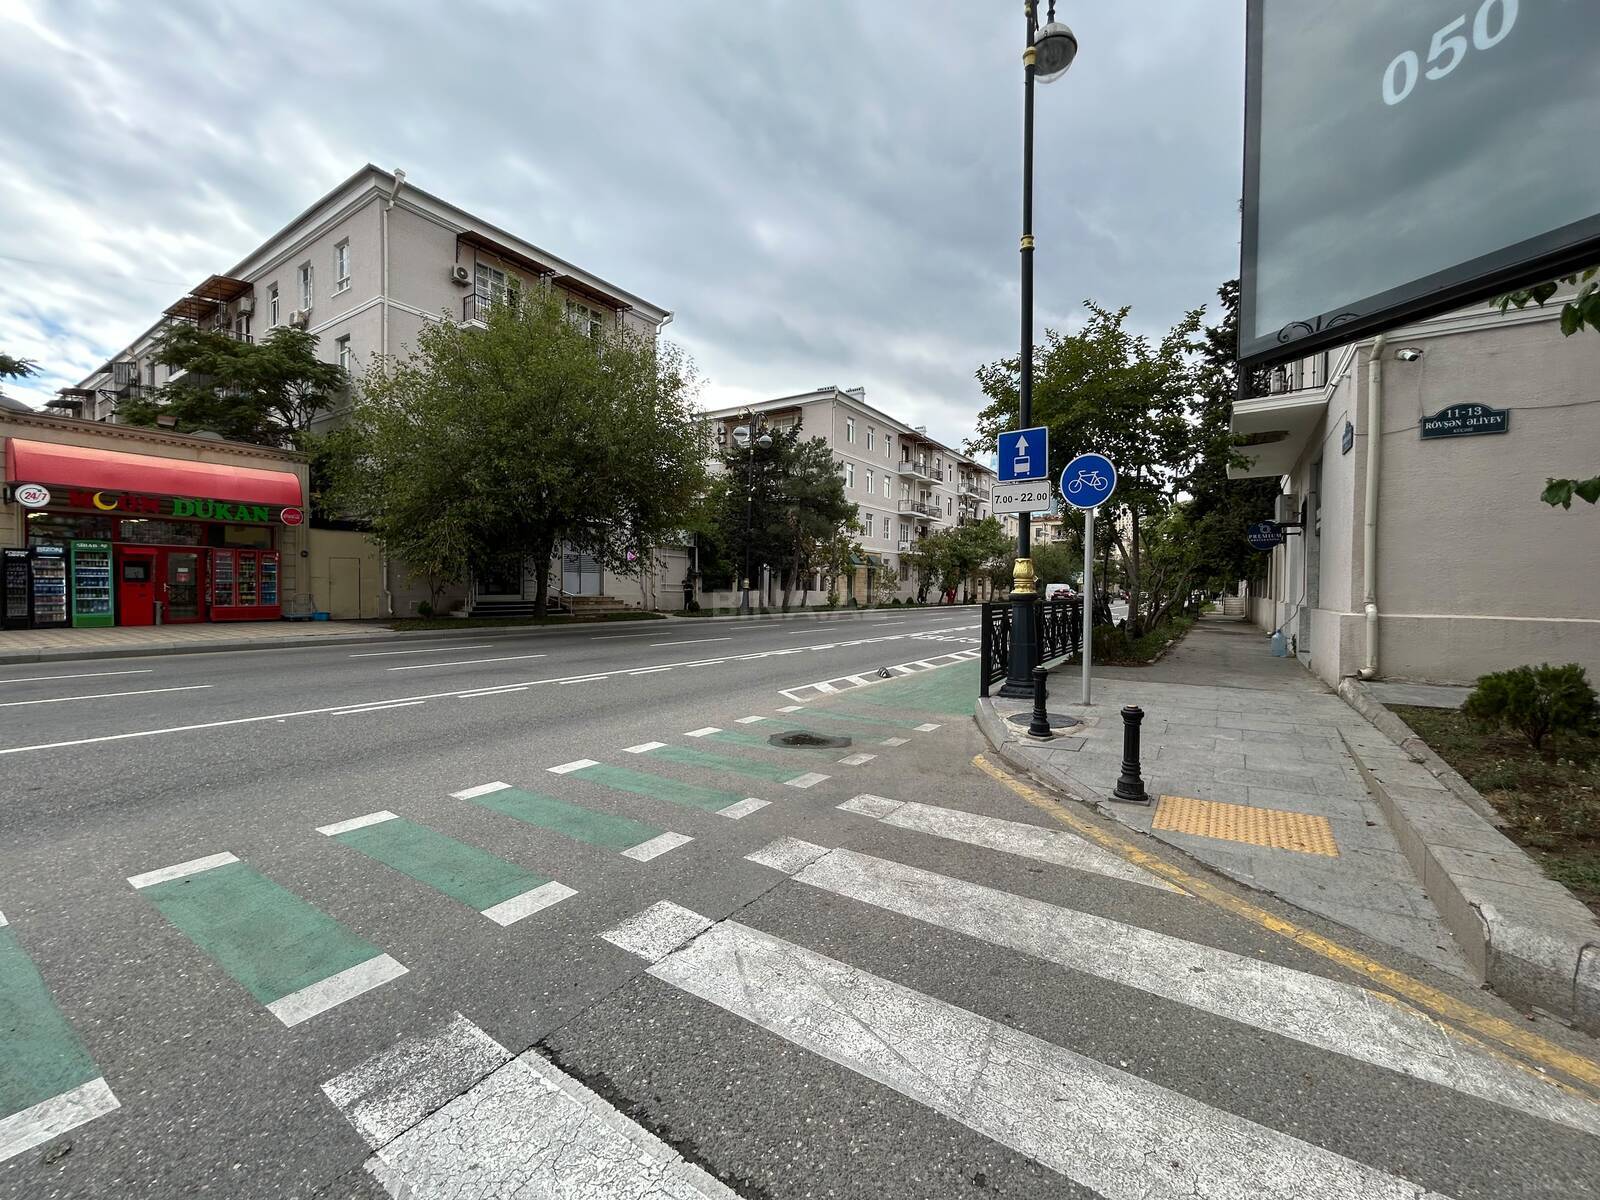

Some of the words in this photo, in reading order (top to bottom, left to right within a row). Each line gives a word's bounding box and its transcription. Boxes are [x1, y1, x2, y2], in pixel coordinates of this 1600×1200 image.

[1382, 0, 1519, 106] 050
[1447, 406, 1482, 418] 11-13
[1466, 415, 1503, 426] ƏLİYEV
[24, 491, 47, 501] 24/7
